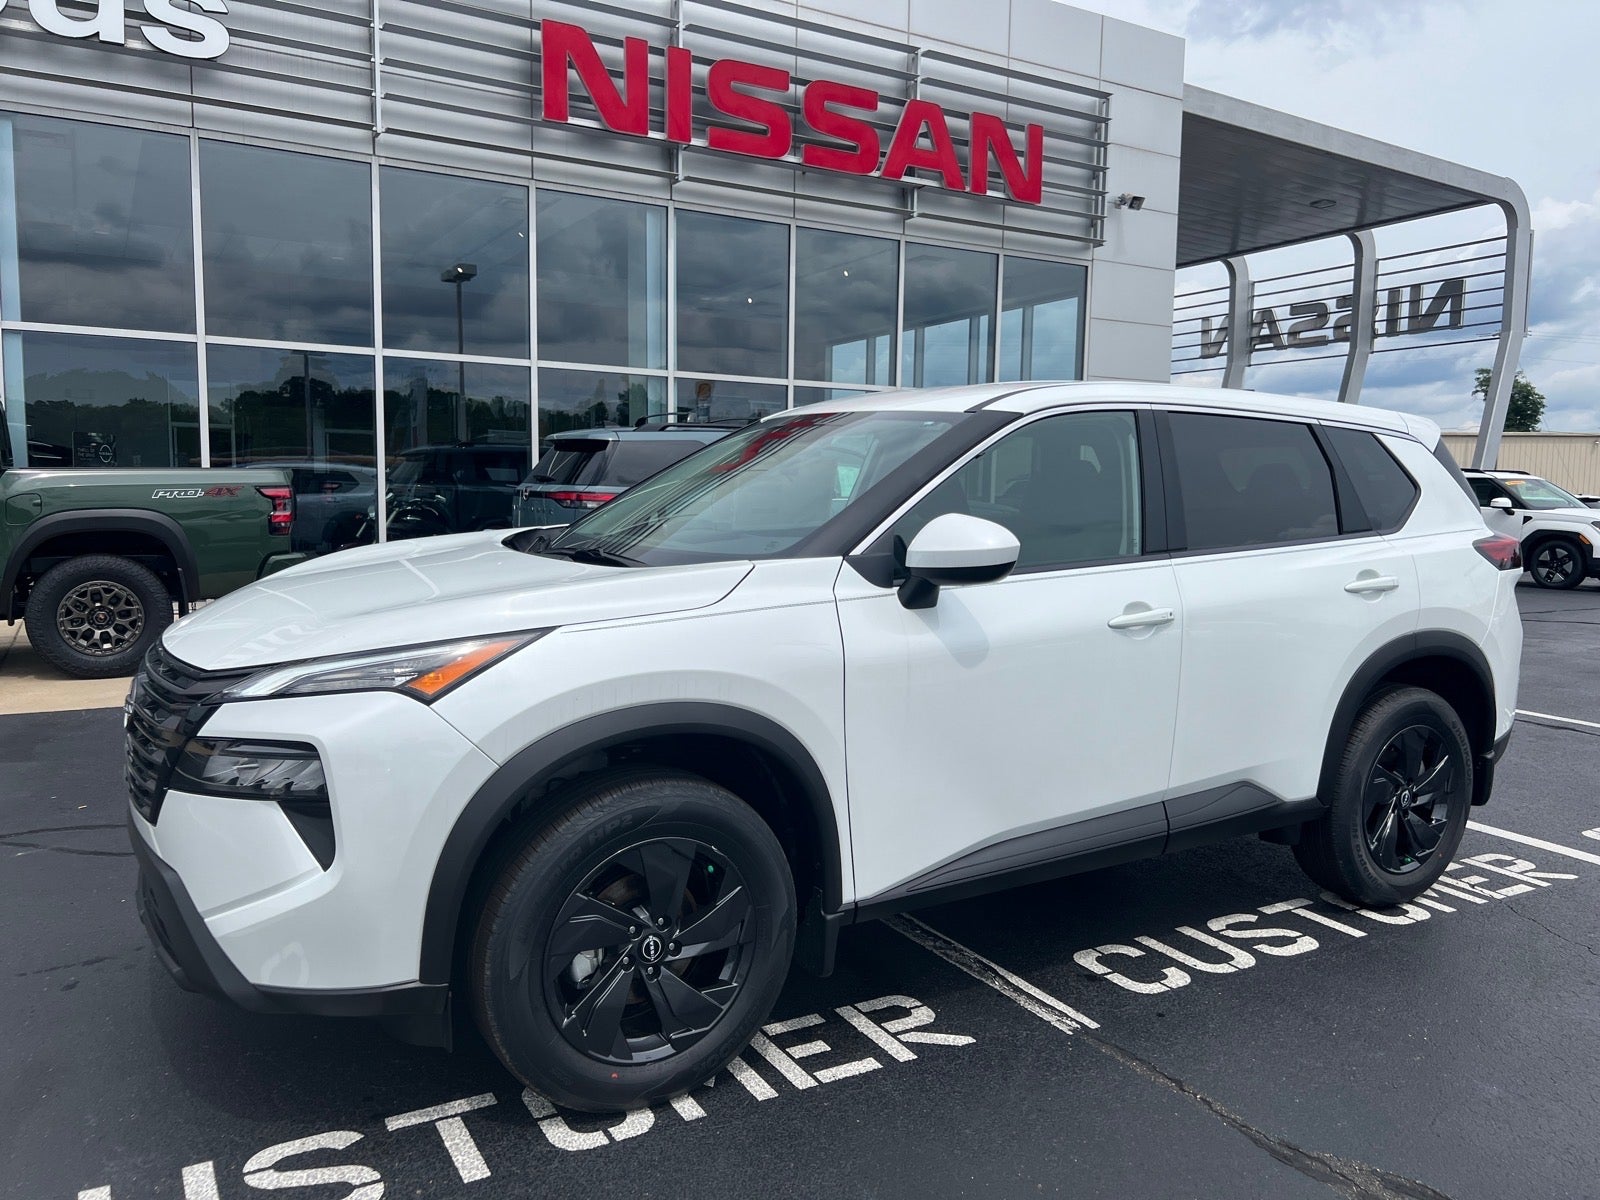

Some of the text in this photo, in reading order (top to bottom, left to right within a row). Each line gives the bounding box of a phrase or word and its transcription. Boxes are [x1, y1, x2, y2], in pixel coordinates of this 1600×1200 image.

[0, 0, 230, 59] us
[541, 19, 1044, 204] NISSAN
[1073, 853, 1579, 994] CUSTOMER
[78, 994, 977, 1200] STOER
